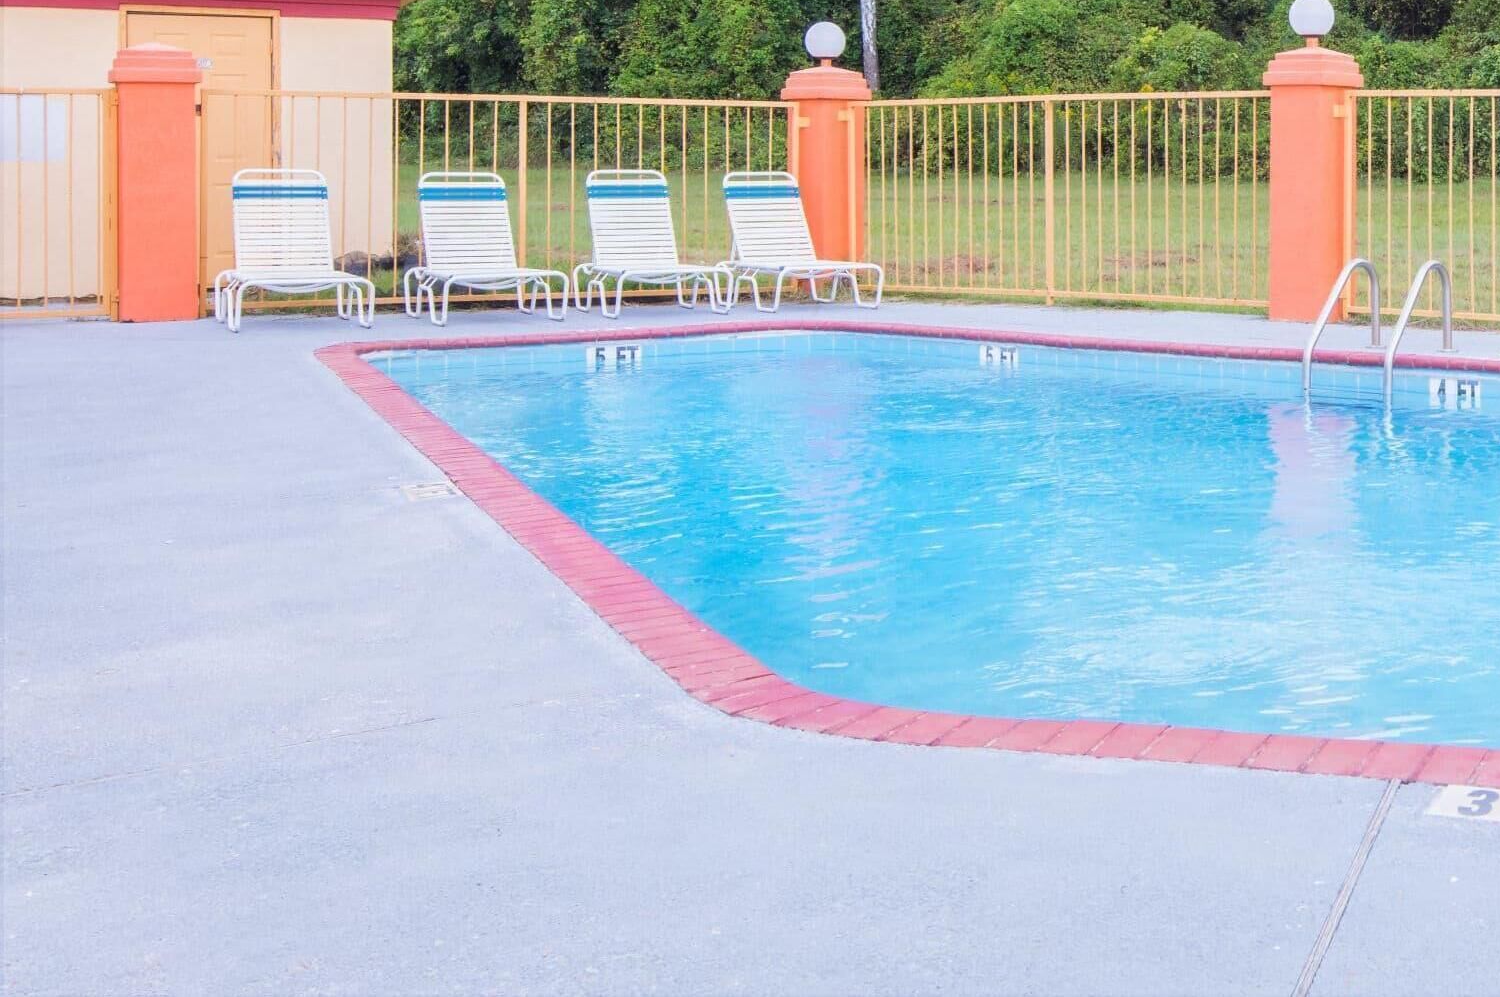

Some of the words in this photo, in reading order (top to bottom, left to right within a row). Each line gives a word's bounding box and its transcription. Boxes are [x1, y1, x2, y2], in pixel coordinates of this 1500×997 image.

[616, 345, 640, 361] FT
[1457, 380, 1479, 398] FT
[1457, 789, 1500, 817] 3
